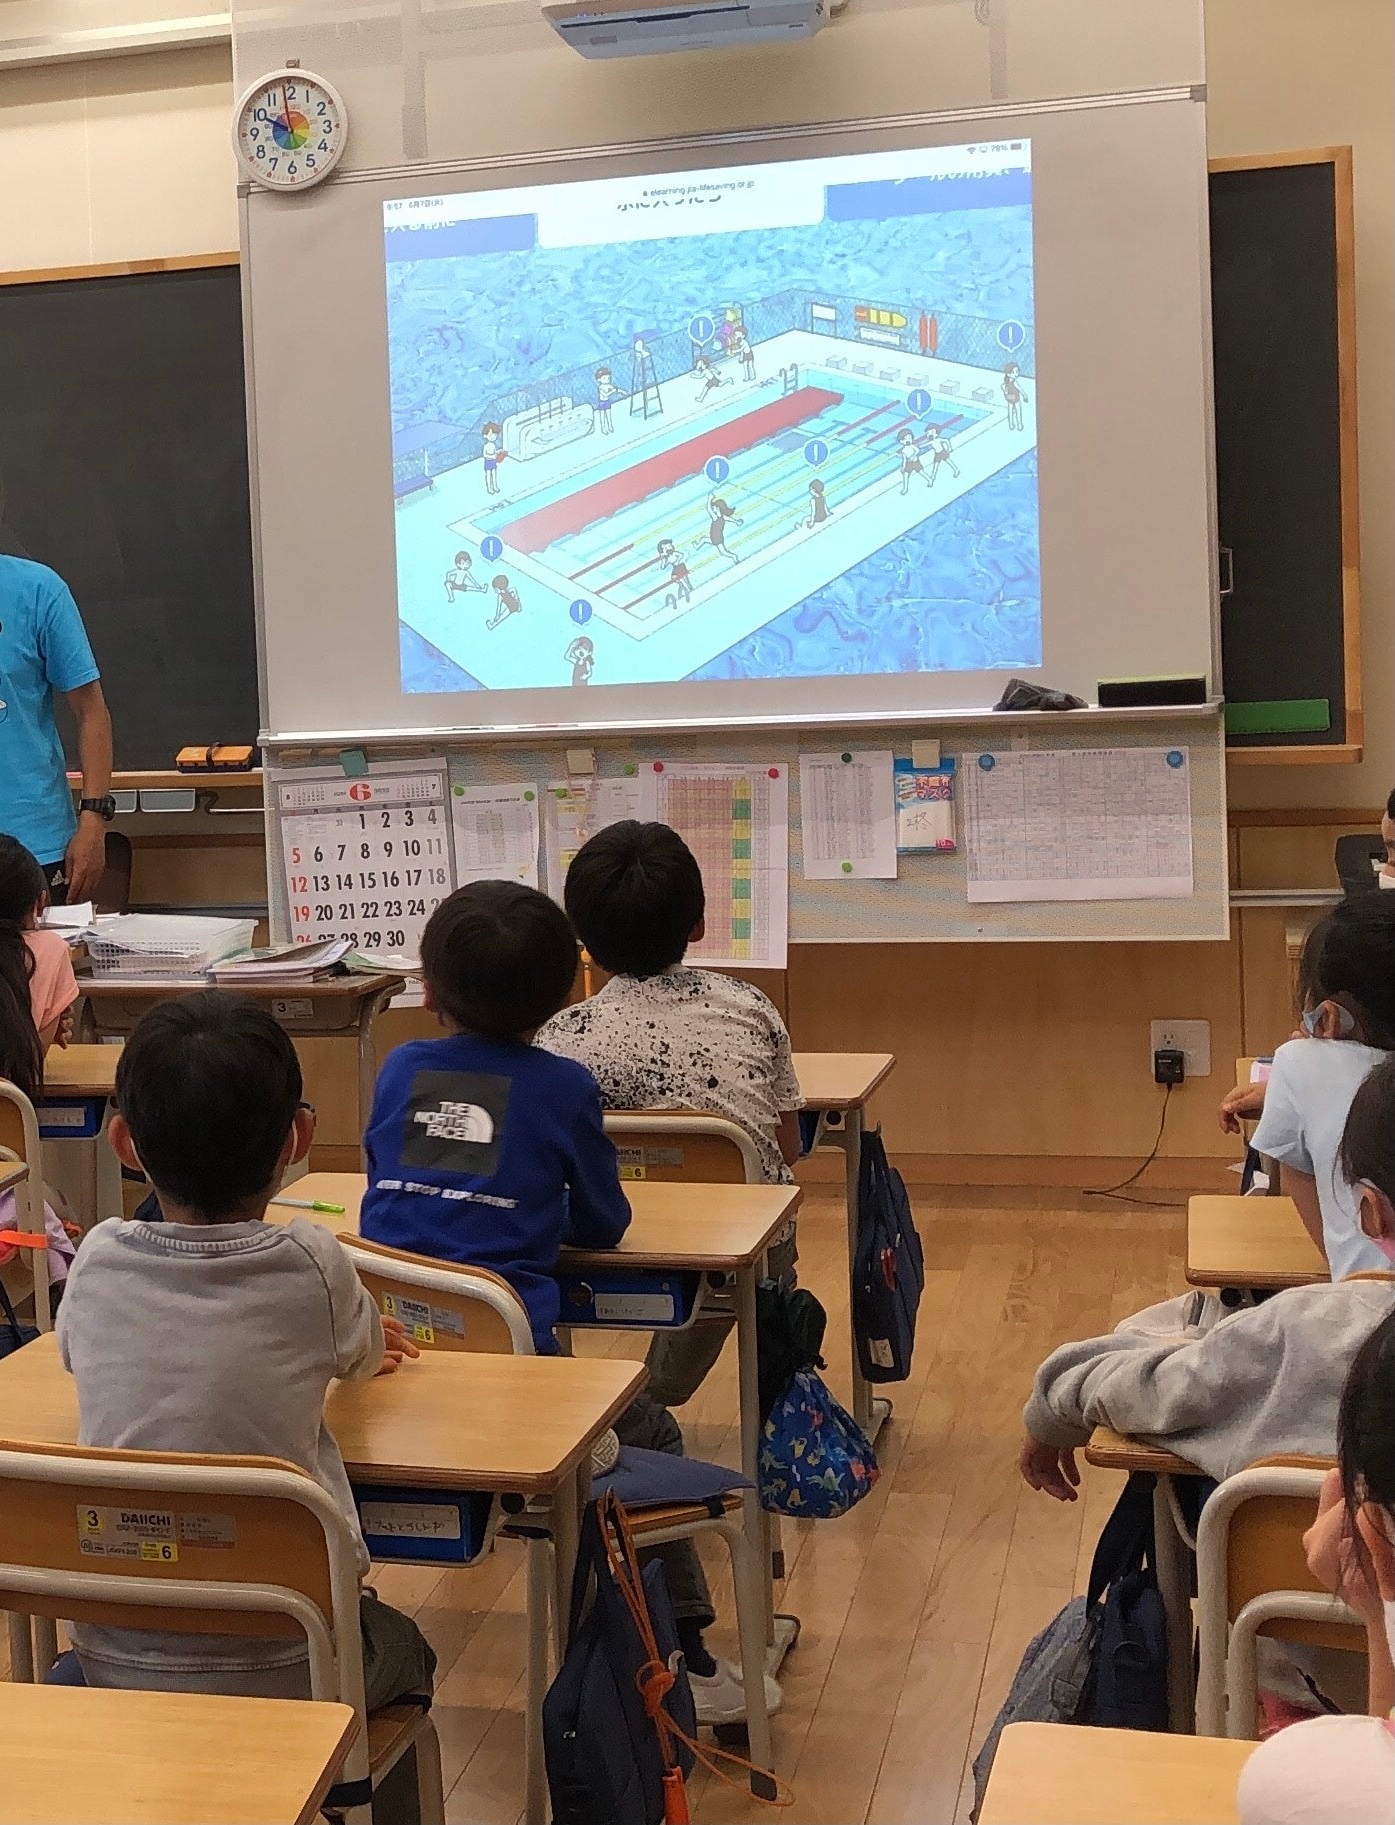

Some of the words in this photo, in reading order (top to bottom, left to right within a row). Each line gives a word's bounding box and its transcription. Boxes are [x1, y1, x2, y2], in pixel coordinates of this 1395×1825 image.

[268, 92, 276, 107] 11
[305, 90, 310, 103] 1
[254, 108, 267, 122] 10
[317, 102, 326, 116] 2
[323, 120, 332, 134] 3
[250, 128, 259, 141] 9
[256, 145, 265, 159] 8
[318, 138, 328, 152] 4
[269, 158, 278, 171] 7
[288, 161, 297, 174] 6
[306, 154, 315, 168] 5
[350, 783, 371, 801] 6
[359, 813, 365, 830] 1
[381, 812, 390, 828] 2
[404, 810, 414, 827] 3
[427, 809, 437, 825] 4
[292, 847, 301, 864] 5
[314, 846, 323, 862] 6
[337, 844, 346, 861] 7
[361, 843, 370, 859] 8
[383, 841, 393, 858] 9
[403, 839, 421, 856] 10
[427, 838, 442, 855] 11
[290, 876, 308, 893] 12
[313, 875, 331, 892] 13
[336, 874, 353, 890] 14
[359, 872, 377, 889] 15
[382, 871, 400, 888] 16
[406, 869, 422, 886] 17
[428, 868, 446, 885] 18
[294, 906, 310, 922] 19
[315, 904, 333, 921] 20
[338, 903, 355, 920] 21
[361, 902, 379, 918] 22
[384, 900, 403, 917] 23
[407, 899, 426, 916] 24
[364, 931, 381, 948] 29
[387, 930, 405, 947] 30
[278, 1002, 286, 1012] 3
[439, 1101, 470, 1113] THE
[414, 1112, 468, 1127] NORTH
[426, 1125, 467, 1140] FACE
[634, 1168, 641, 1178] 6
[404, 1182, 441, 1196] STOP
[387, 1296, 392, 1309] 3
[424, 1329, 430, 1341] 6
[87, 1510, 98, 1527] 3
[121, 1513, 171, 1526] DAIICHI
[161, 1545, 171, 1559] 6
